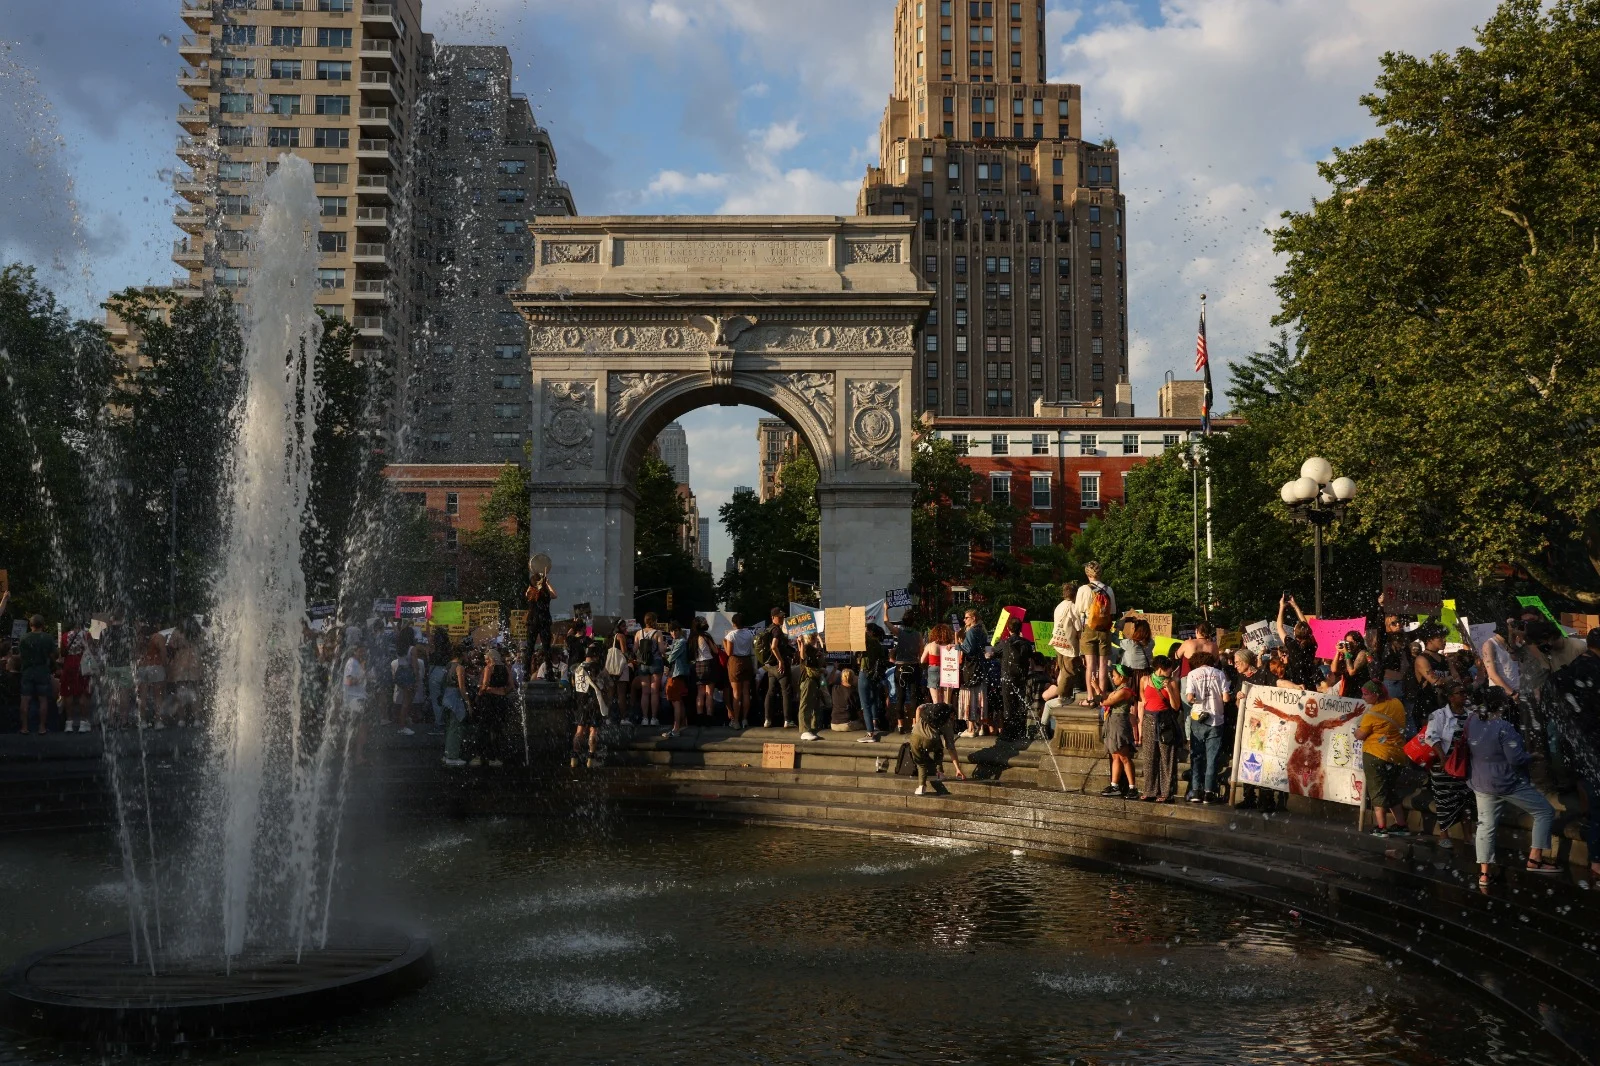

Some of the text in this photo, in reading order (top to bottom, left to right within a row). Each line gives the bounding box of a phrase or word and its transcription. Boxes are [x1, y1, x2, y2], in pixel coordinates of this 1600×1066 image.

[787, 614, 812, 626] WE HAVE
[1144, 614, 1171, 624] SUPREME
[1270, 690, 1303, 704] MY BODY
